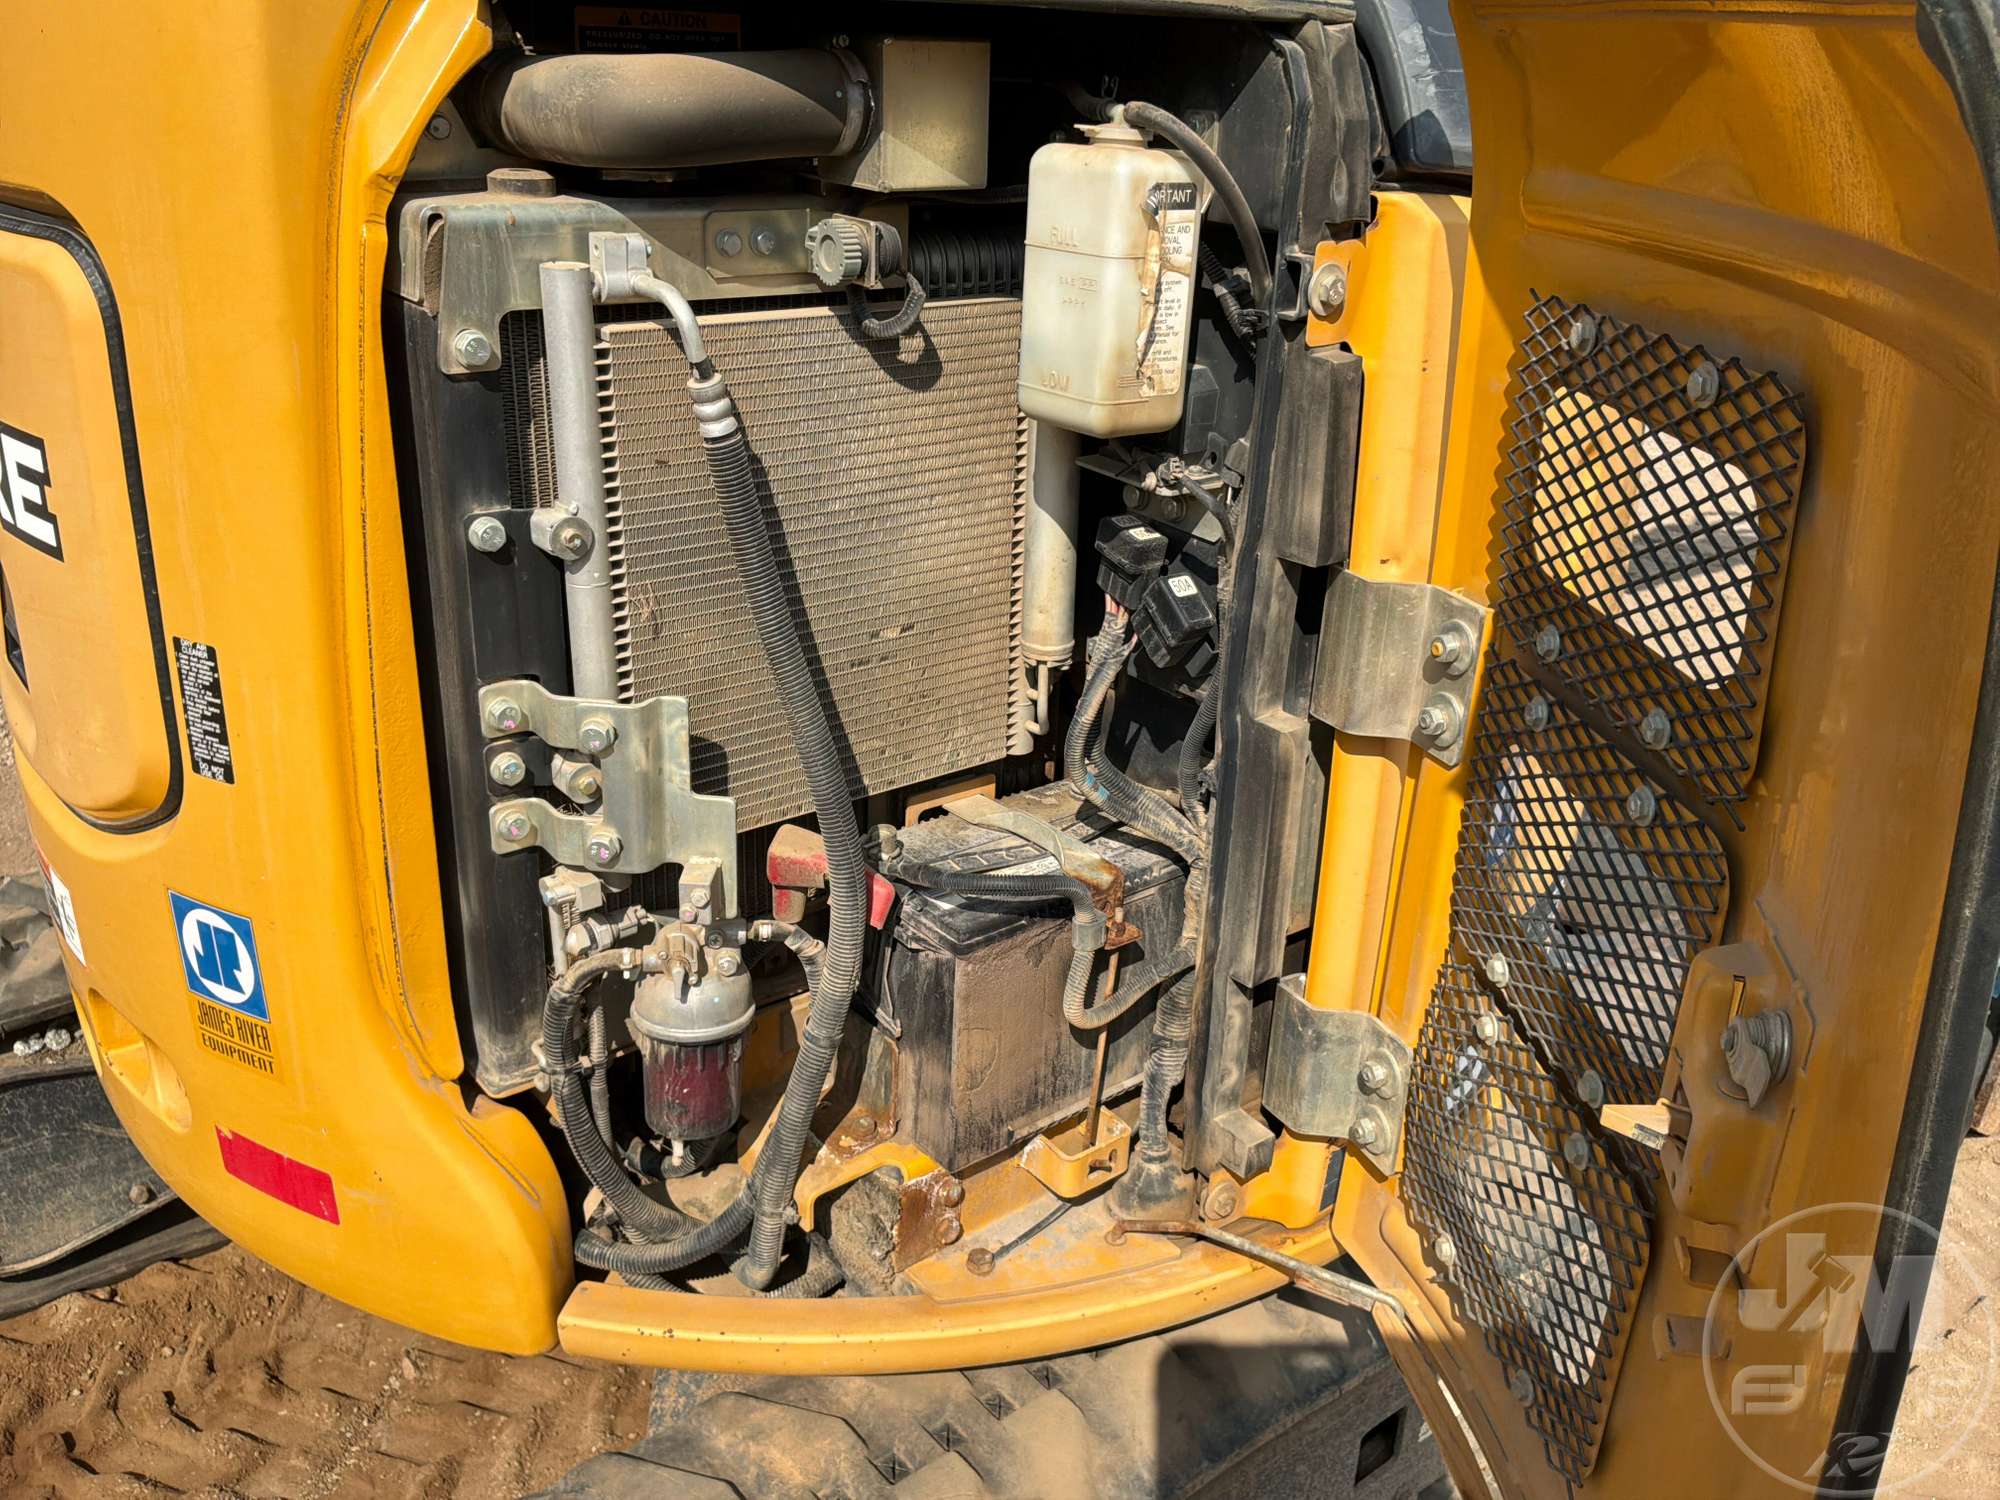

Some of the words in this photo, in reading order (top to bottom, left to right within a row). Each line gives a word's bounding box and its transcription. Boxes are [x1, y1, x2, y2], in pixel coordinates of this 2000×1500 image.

[639, 11, 707, 29] CAUTION
[1177, 225, 1190, 233] AND
[181, 647, 208, 659] CLEANER
[211, 766, 224, 775] NOT
[198, 1000, 235, 1039] JAMES
[237, 1016, 273, 1054] RIVER
[202, 1032, 275, 1075] EQUIPMENT
